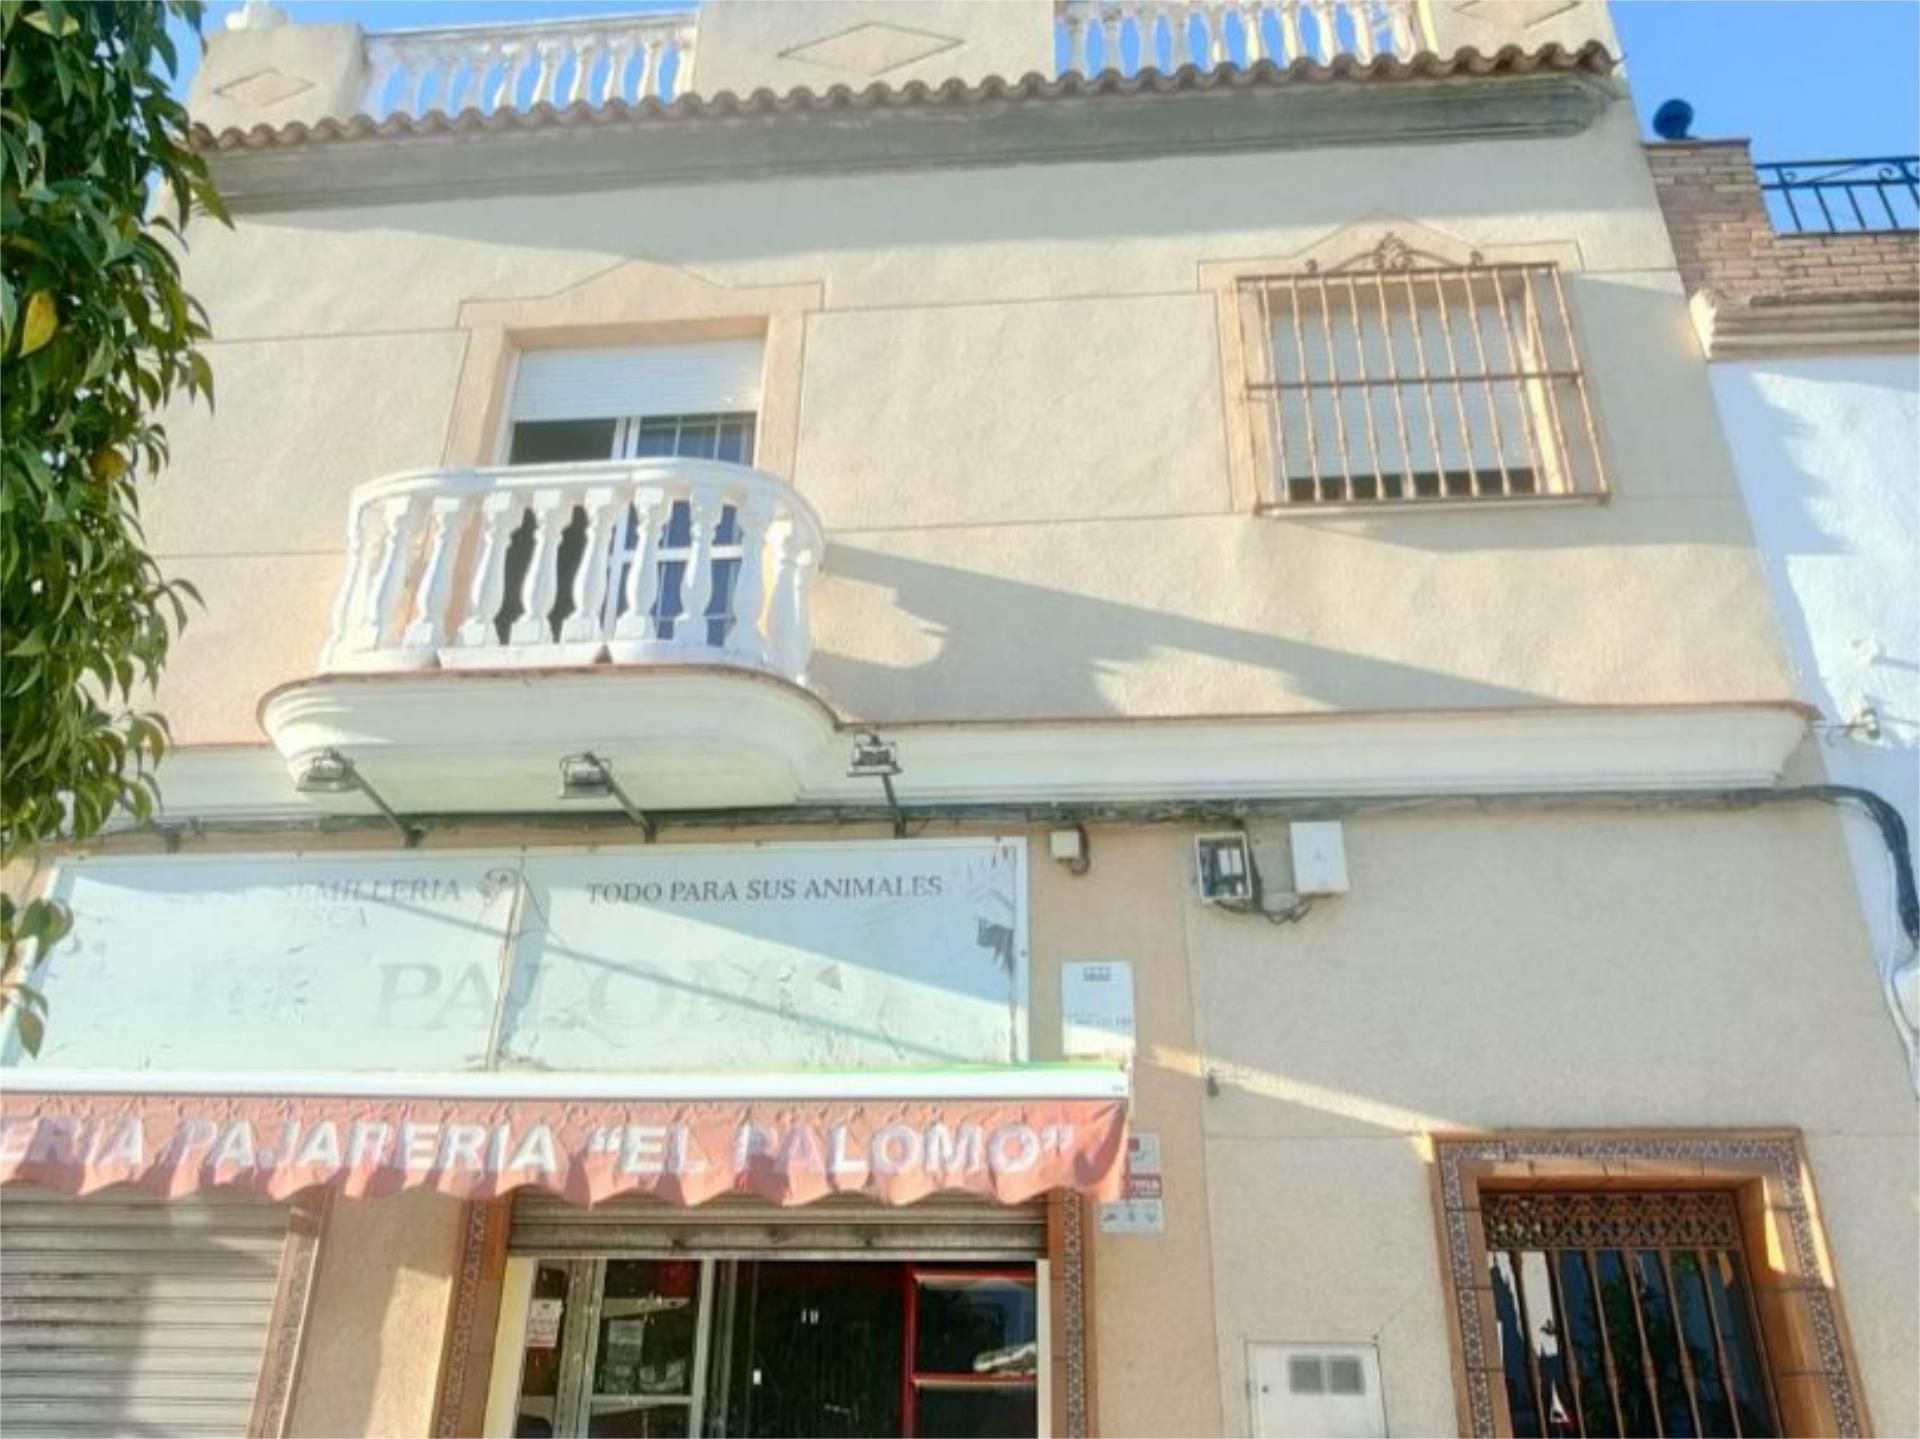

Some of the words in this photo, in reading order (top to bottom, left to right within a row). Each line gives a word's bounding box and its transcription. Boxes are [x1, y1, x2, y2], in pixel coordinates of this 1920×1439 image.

[587, 882, 662, 903] TODO
[670, 880, 738, 901] PARA
[747, 878, 796, 900] SUS
[803, 875, 943, 899] ANIMALES
